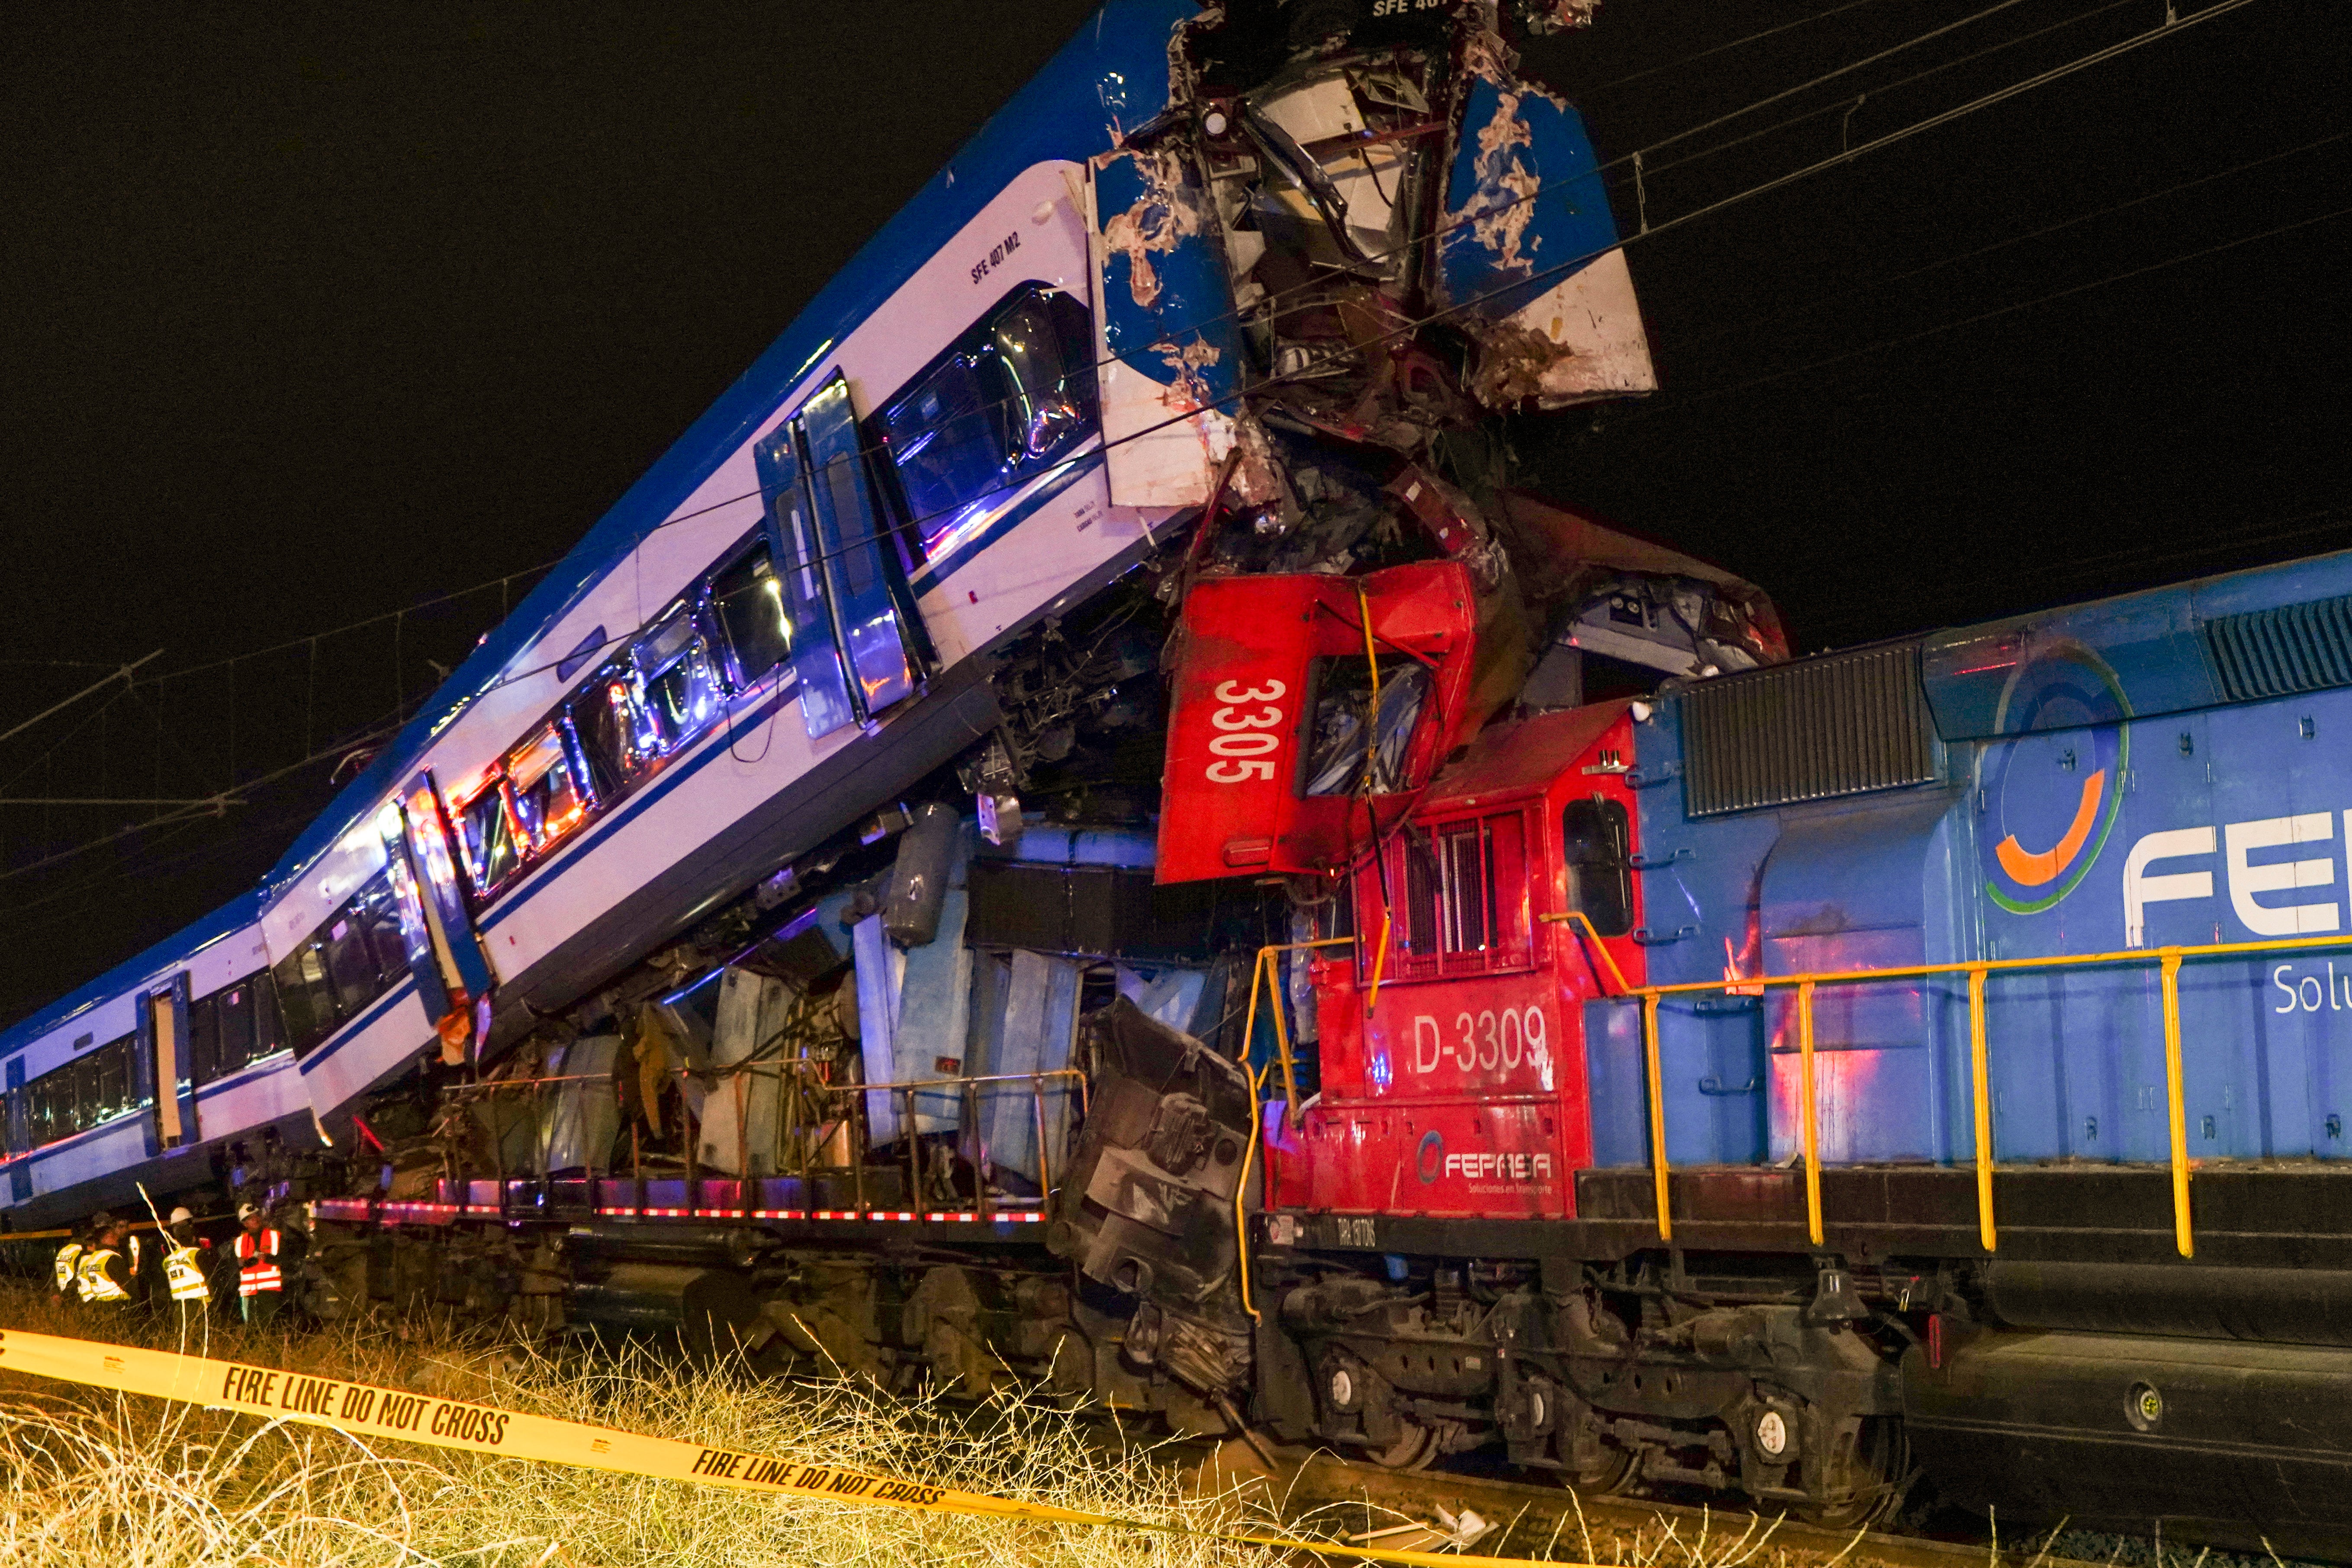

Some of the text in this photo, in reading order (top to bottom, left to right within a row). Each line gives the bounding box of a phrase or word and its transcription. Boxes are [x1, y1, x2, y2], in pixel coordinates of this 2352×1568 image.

[1373, 0, 1408, 16] SFE
[971, 231, 1020, 284] SFE 407 M2
[1206, 679, 1286, 783] 3305
[2123, 808, 2352, 950] FE
[1415, 1005, 1548, 1074] D-3309
[1445, 1153, 1551, 1179] FEPASA
[222, 1366, 509, 1445] FIRE LINE DO NOT CROSS
[693, 1449, 946, 1505] FIRE LINE DO NOT CROSS
